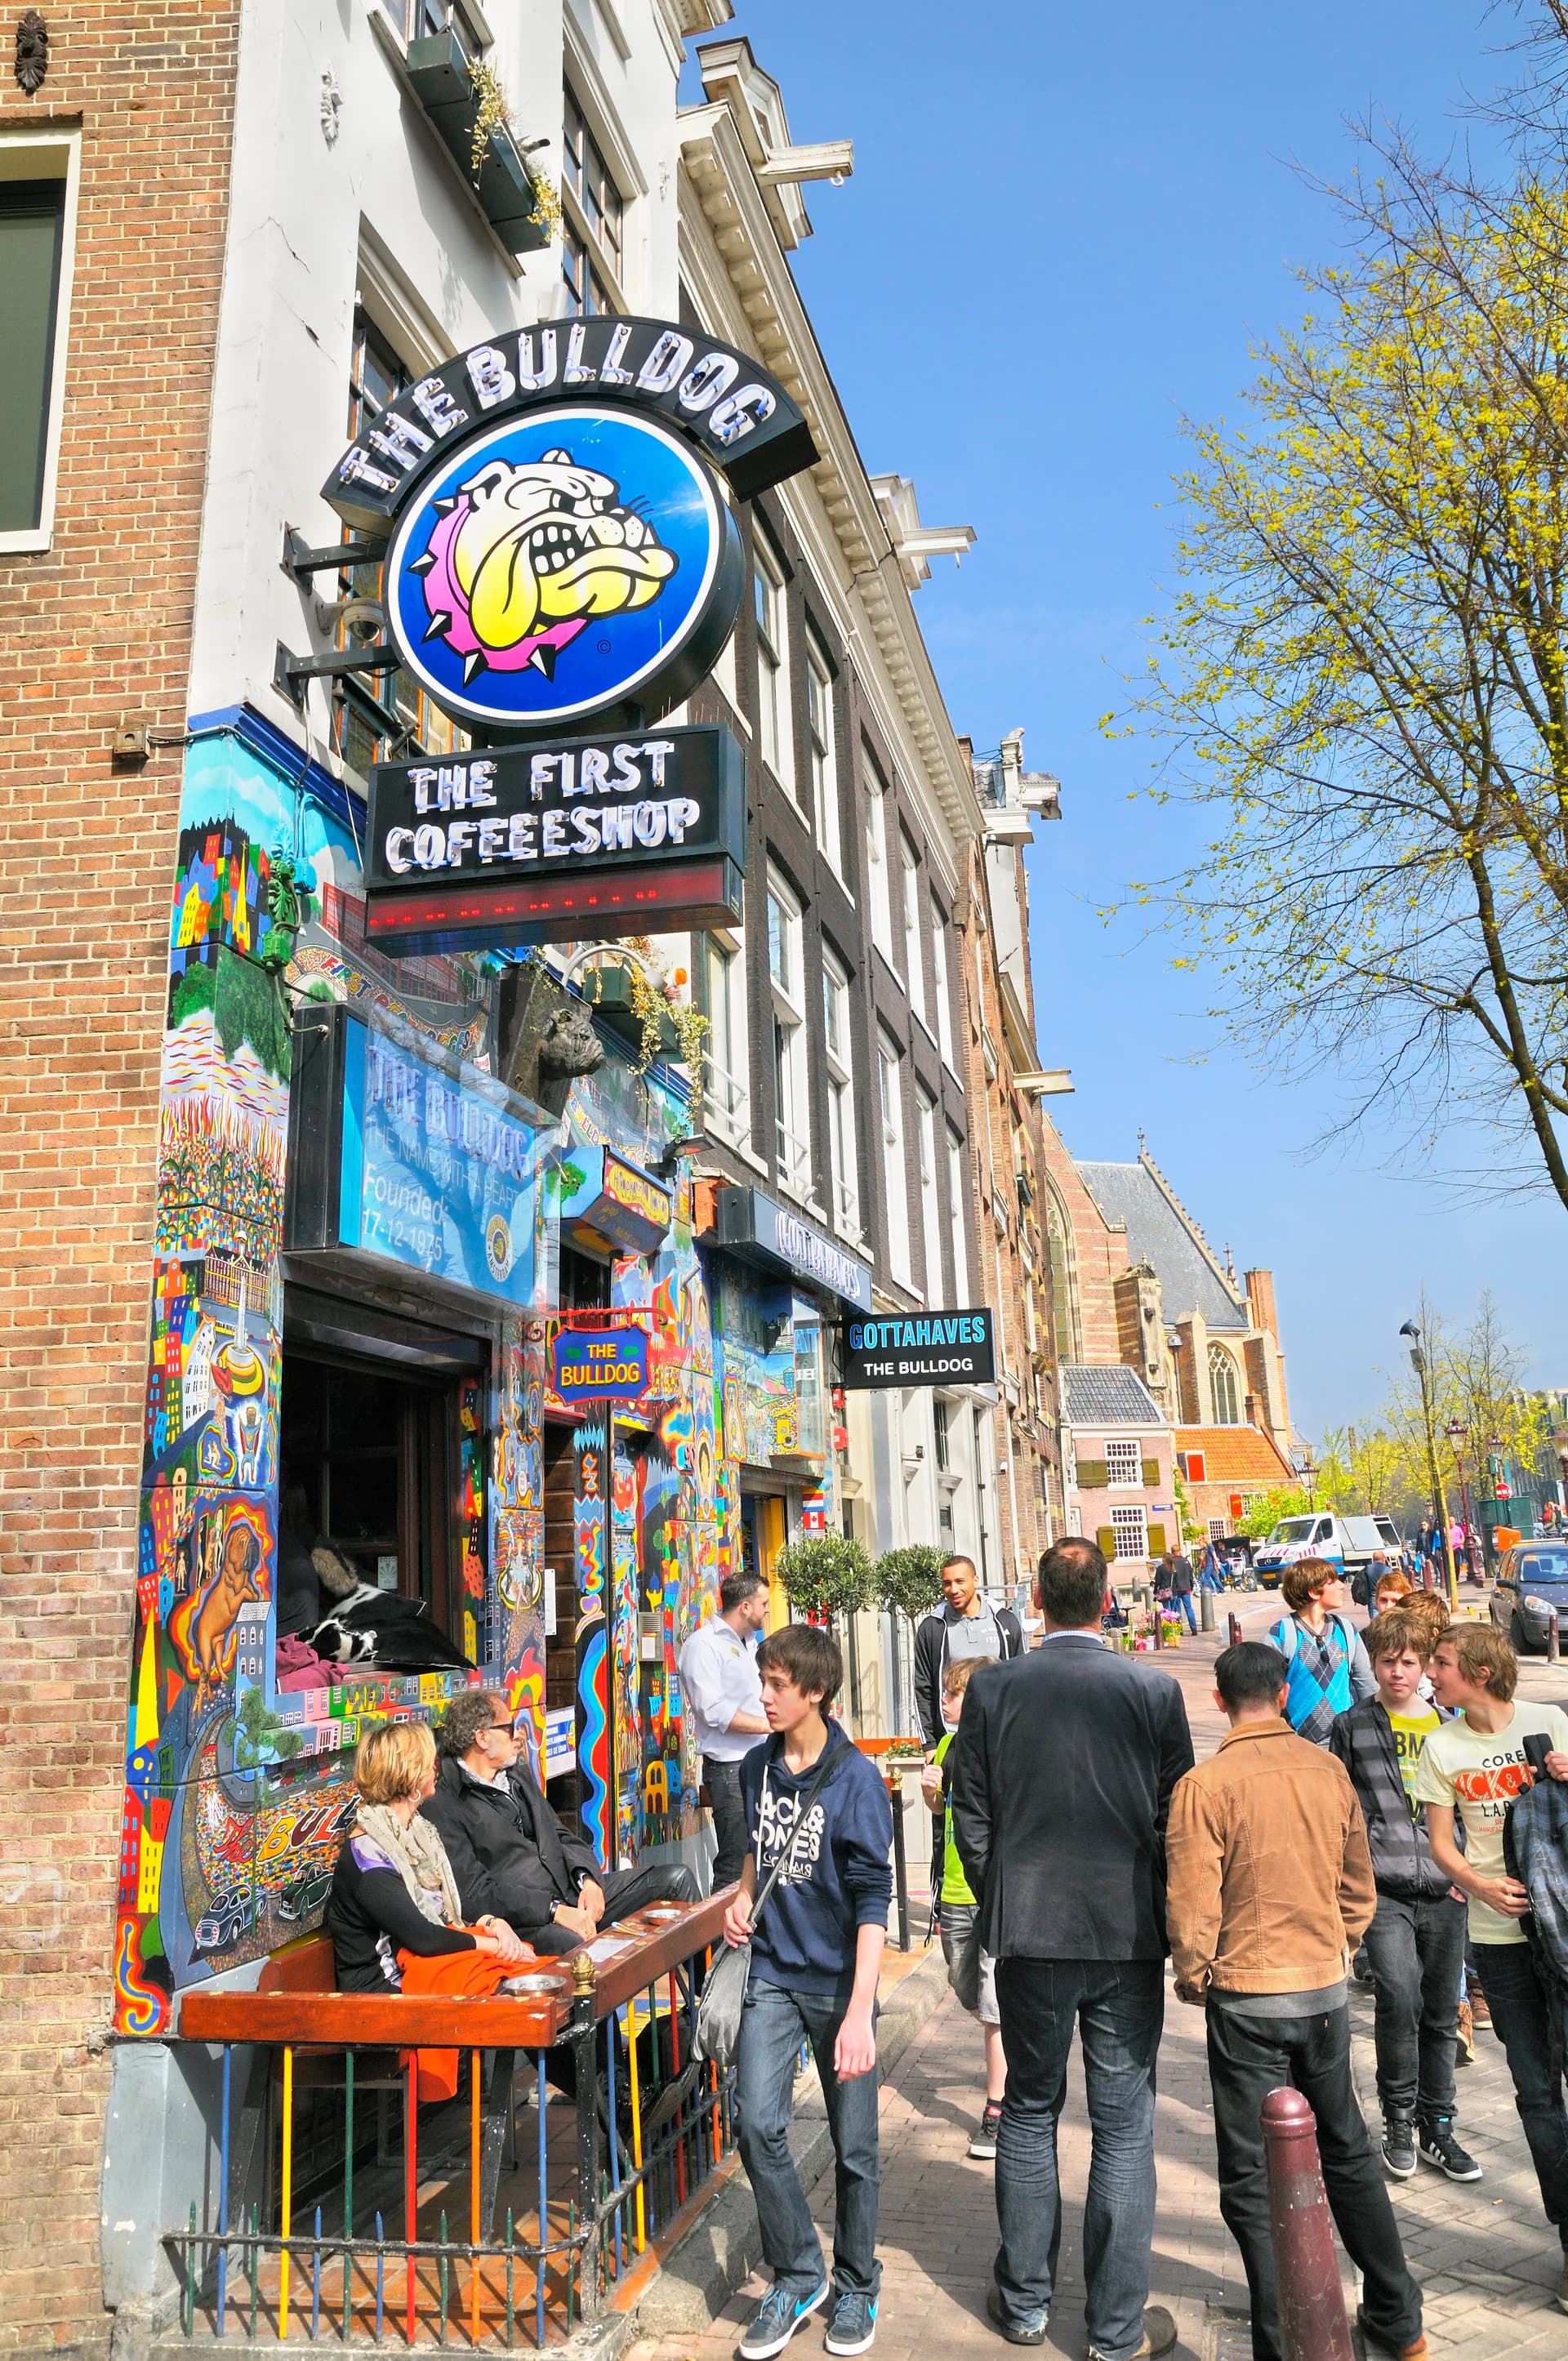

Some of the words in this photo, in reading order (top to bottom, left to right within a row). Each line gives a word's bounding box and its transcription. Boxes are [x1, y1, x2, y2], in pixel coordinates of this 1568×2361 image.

[340, 377, 469, 492] THE
[466, 323, 777, 448] BULLDOG
[408, 760, 498, 815] THE
[530, 741, 675, 801] FIRST
[385, 797, 700, 875] COFFEESHOP
[366, 1120, 395, 1156] THE
[399, 1132, 436, 1176] NAME
[363, 1208, 443, 1262] 17-12-1975
[587, 1343, 617, 1361] THE
[849, 1316, 986, 1350] GOTTAHAVES
[560, 1361, 641, 1388] BULLDOG
[863, 1361, 895, 1377] THE
[898, 1356, 973, 1374] BULLDOG
[1482, 1749, 1526, 1769] CORE
[213, 1815, 255, 1864] The
